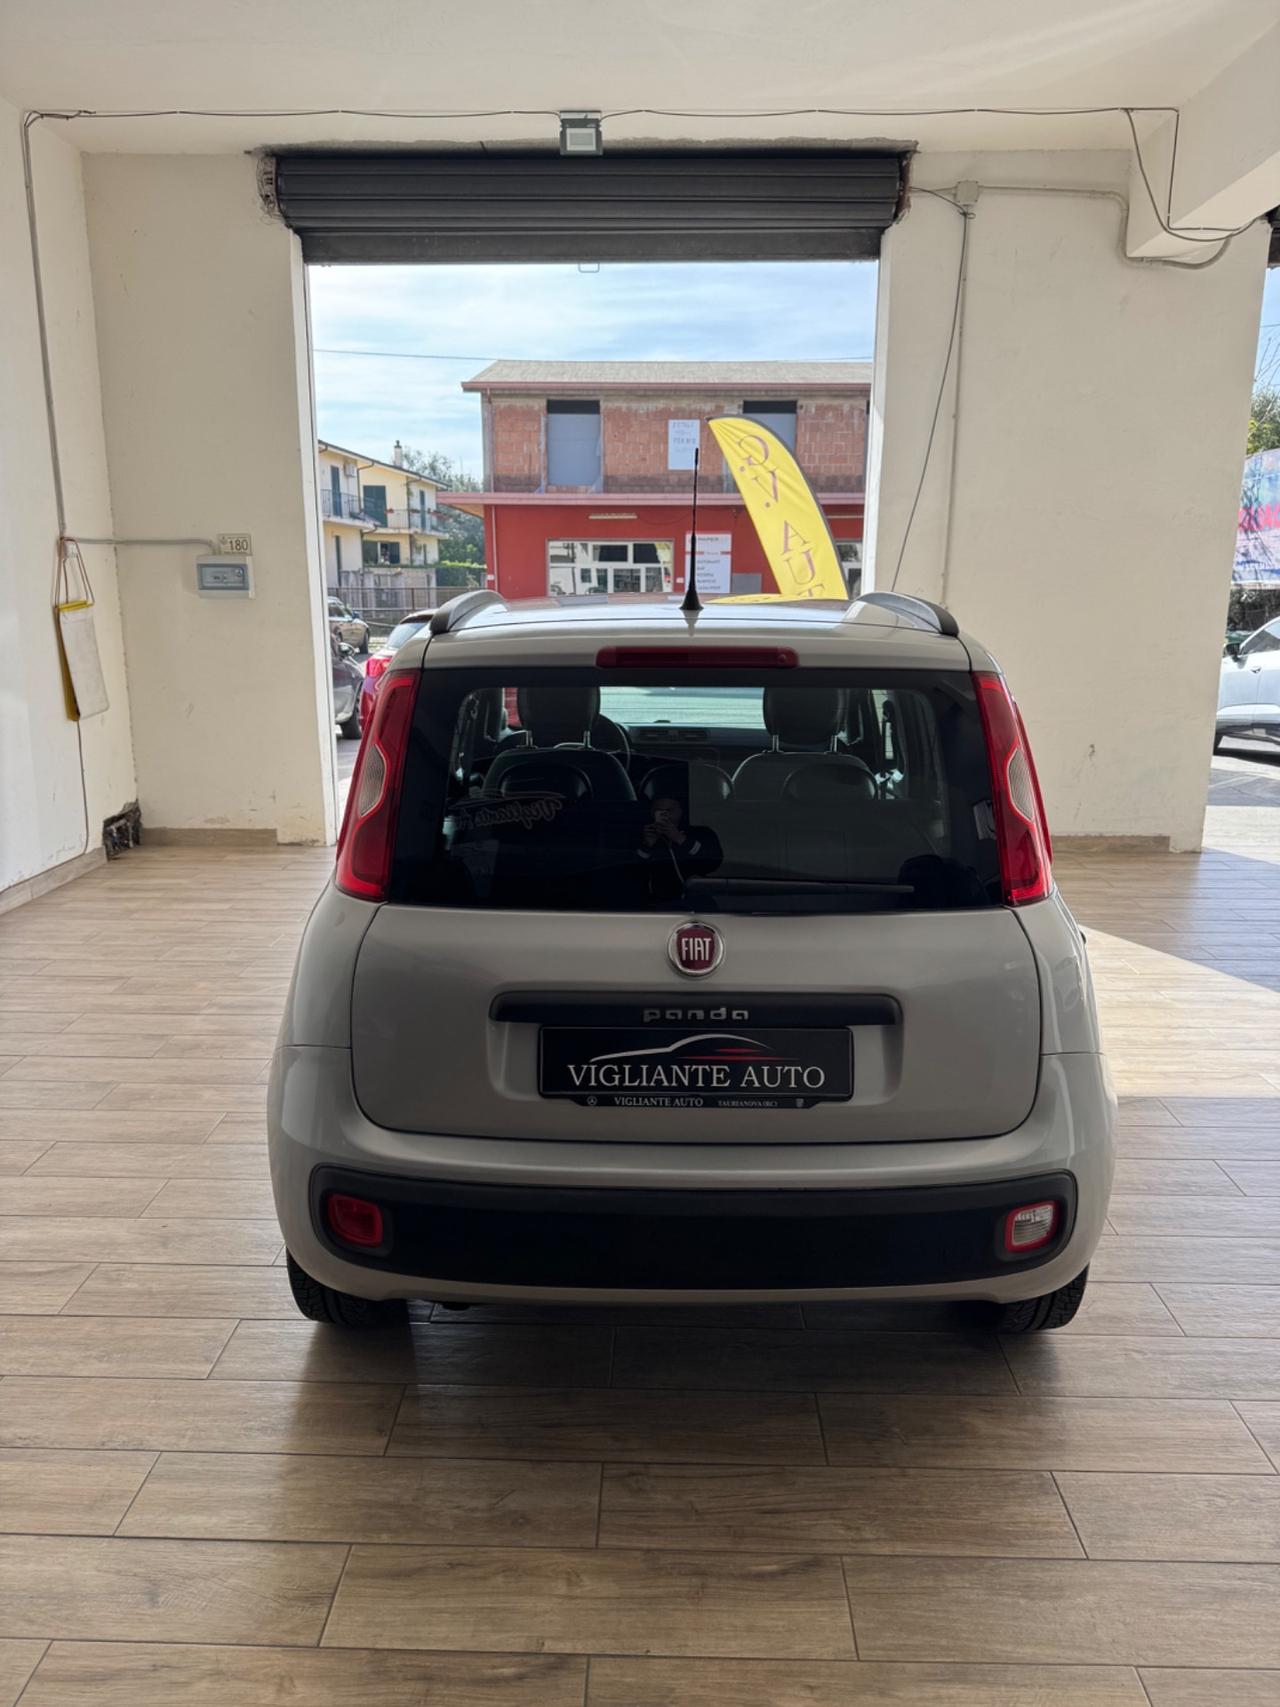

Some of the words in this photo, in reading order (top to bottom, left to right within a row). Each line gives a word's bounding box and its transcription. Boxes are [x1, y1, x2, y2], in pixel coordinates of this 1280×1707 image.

[229, 539, 248, 551] 180
[681, 937, 712, 961] FIAT
[643, 1006, 749, 1022] panda
[567, 1064, 731, 1088] VIGLIANTE
[739, 1064, 826, 1089] AUTO
[613, 1096, 672, 1107] VIGLIANTE
[672, 1097, 704, 1108] AUTO
